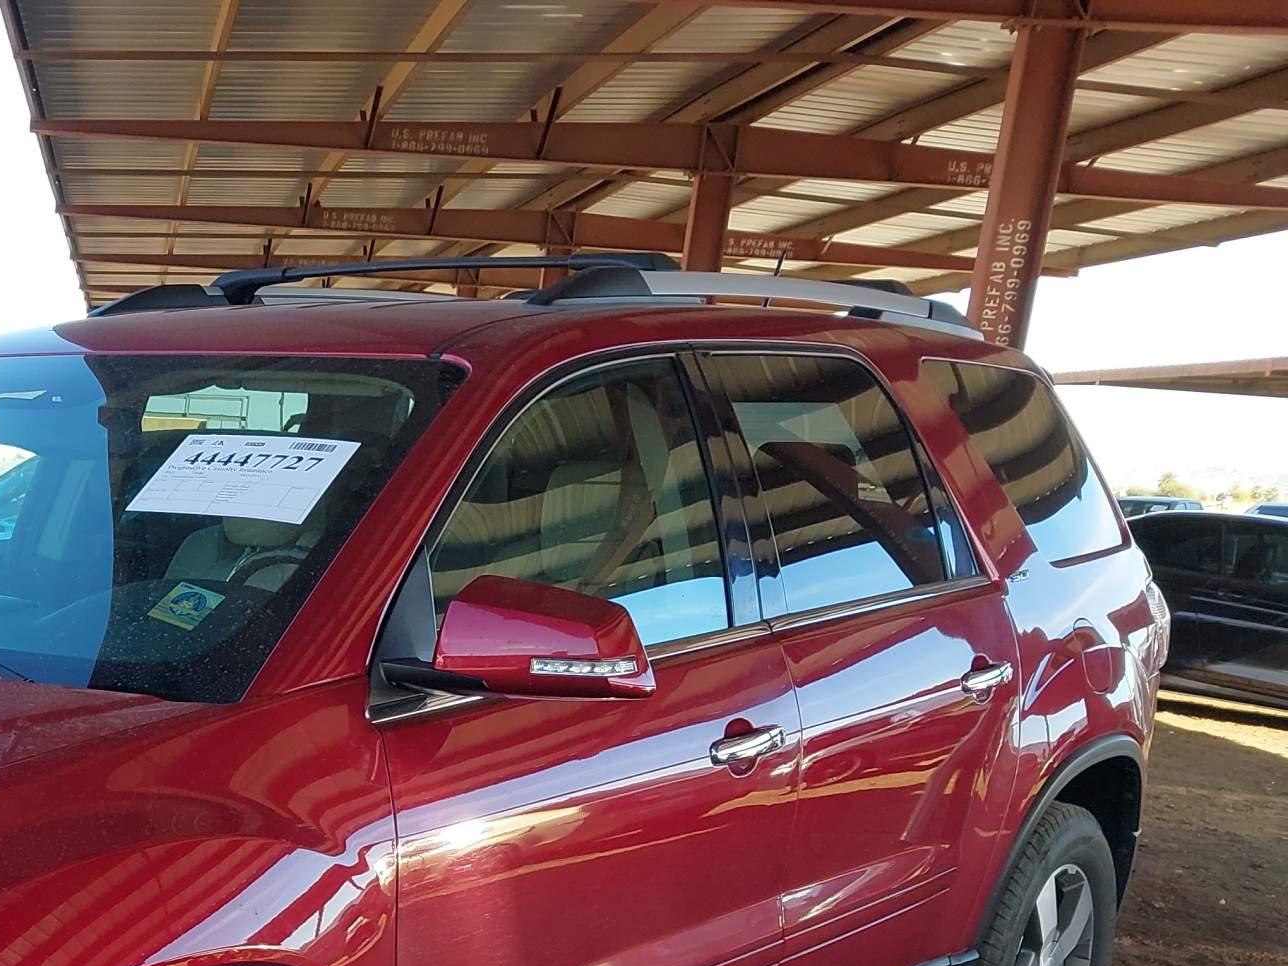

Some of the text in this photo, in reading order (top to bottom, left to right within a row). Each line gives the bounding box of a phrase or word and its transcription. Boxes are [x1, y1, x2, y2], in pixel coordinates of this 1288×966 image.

[980, 218, 1015, 331] PREFAB INC.
[184, 451, 325, 472] 44447727
